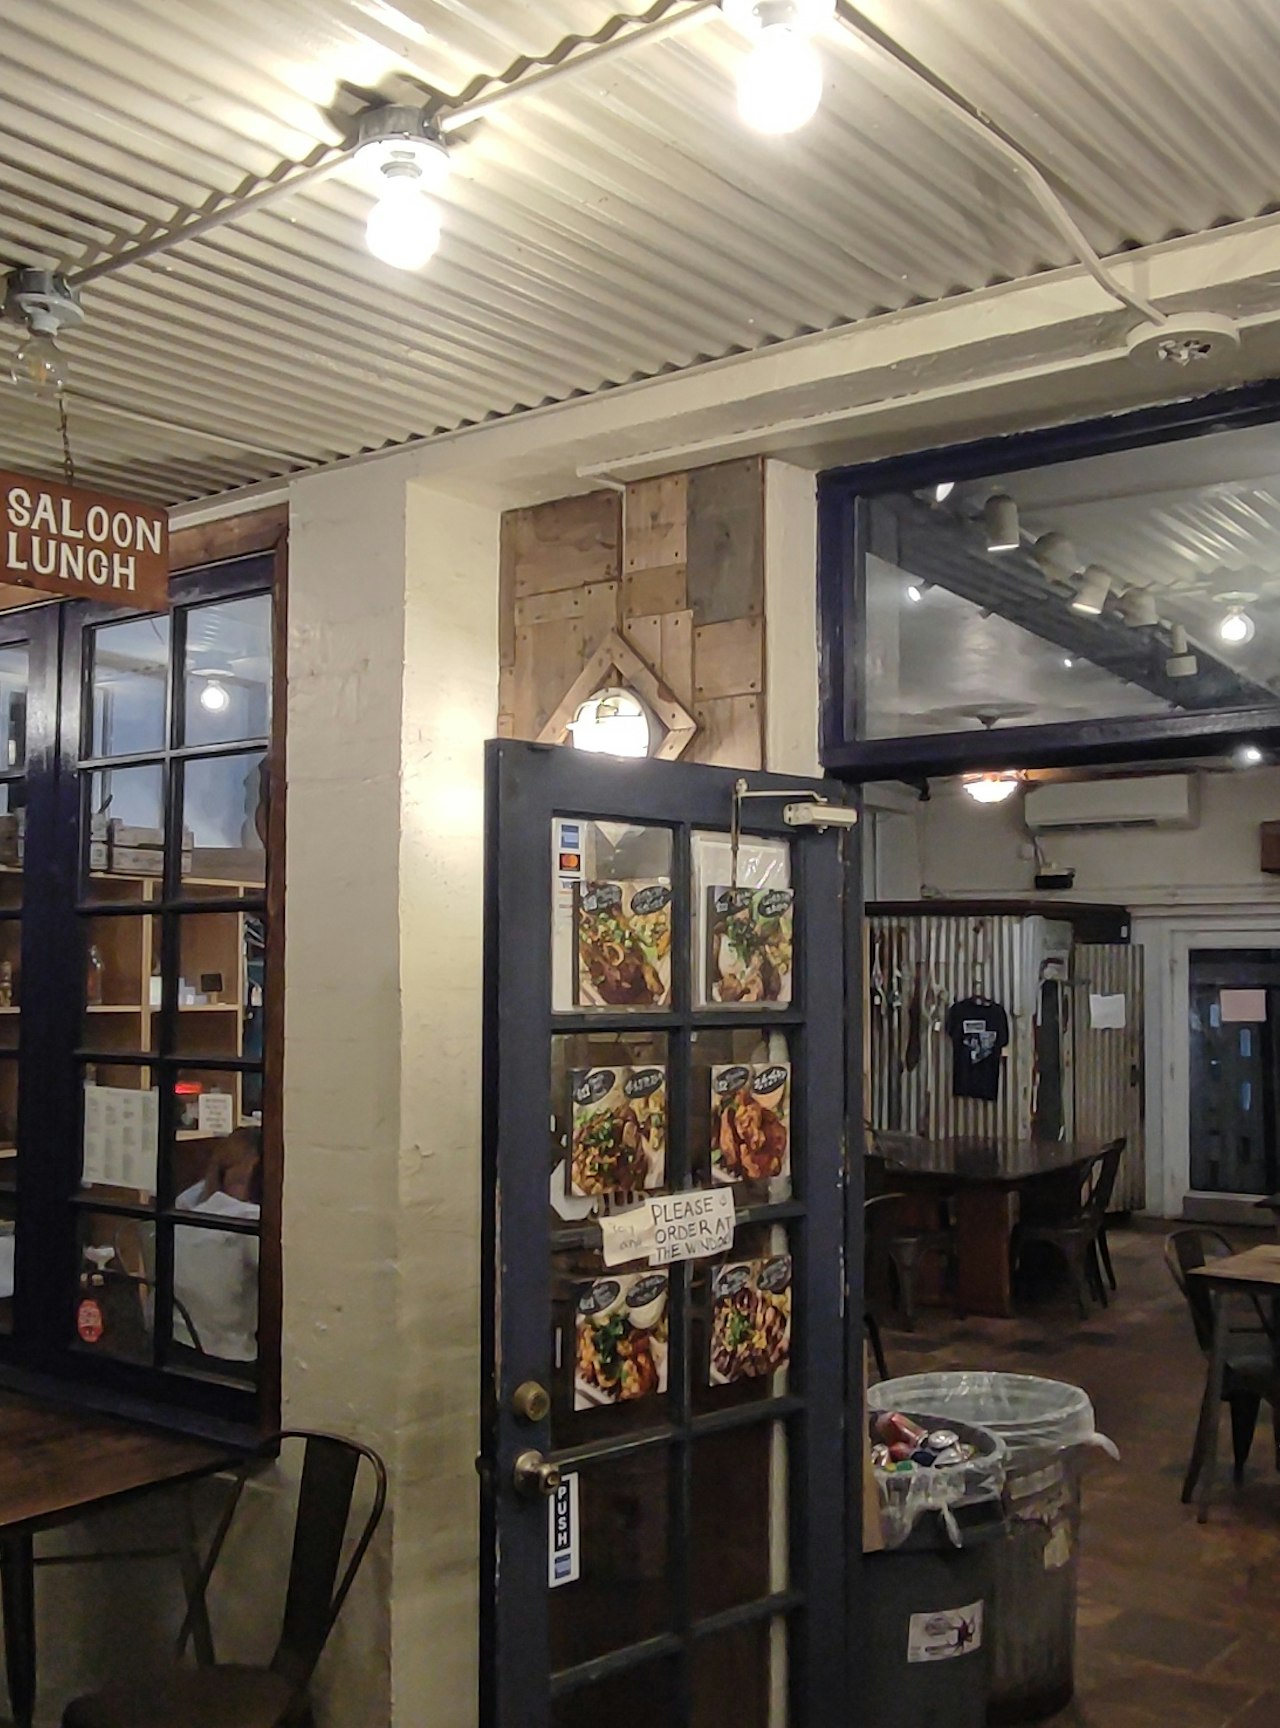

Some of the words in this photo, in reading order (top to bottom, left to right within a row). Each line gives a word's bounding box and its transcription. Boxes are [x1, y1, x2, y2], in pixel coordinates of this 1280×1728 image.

[6, 487, 163, 555] SALOON
[5, 531, 137, 591] LUNCH
[651, 1196, 714, 1226] PLEASE
[655, 1219, 713, 1245] ORDER
[715, 1215, 733, 1236] AT
[656, 1243, 681, 1262] THE
[557, 1486, 568, 1547] PUSH
